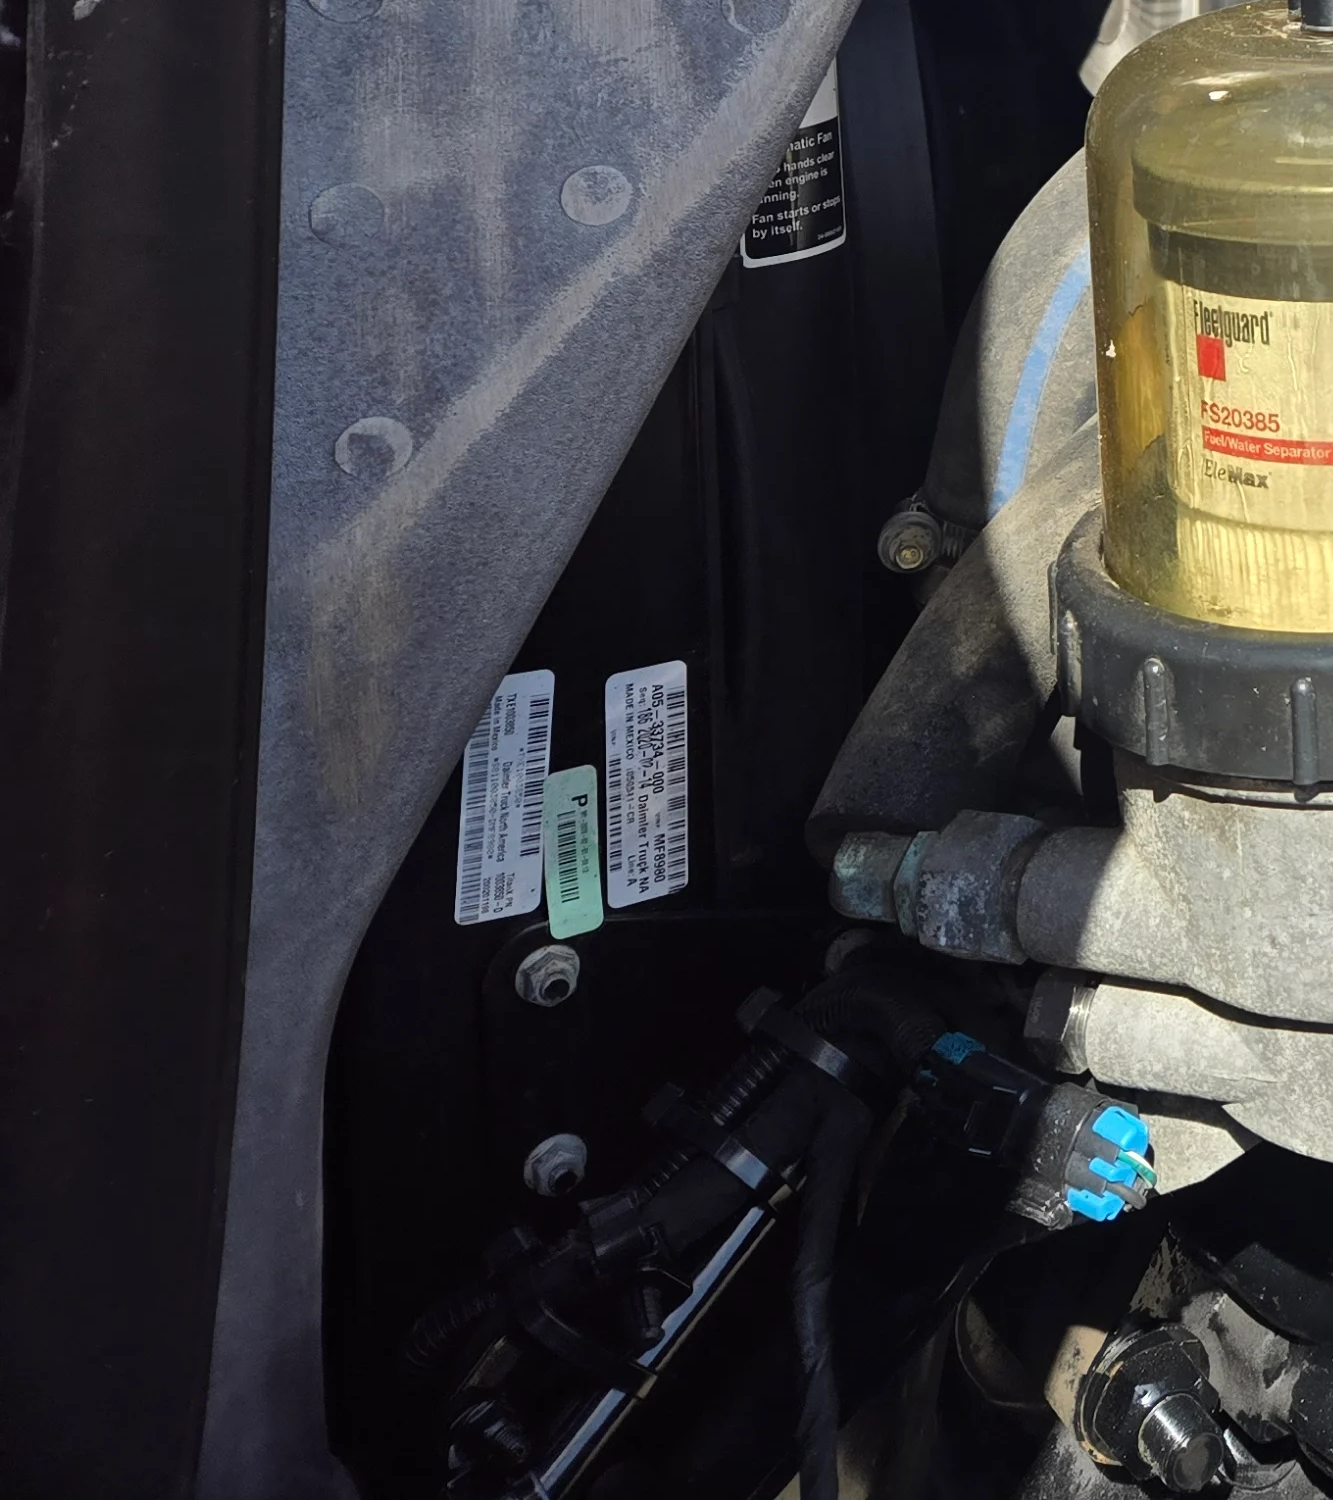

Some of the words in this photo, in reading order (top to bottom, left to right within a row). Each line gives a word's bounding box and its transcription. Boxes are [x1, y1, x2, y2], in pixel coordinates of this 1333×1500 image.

[817, 131, 833, 145] Fan
[783, 157, 816, 172] hands
[816, 150, 835, 164] clear
[785, 171, 819, 187] engine
[752, 212, 774, 225] Fan
[777, 206, 810, 220] starts
[811, 202, 822, 213] or
[822, 194, 841, 209] stops
[752, 227, 768, 240] by
[771, 219, 804, 236] itself.
[1193, 299, 1271, 348] Fleetguard
[1200, 399, 1281, 434] FS20385
[1204, 429, 1262, 455] Fuel/Water
[1263, 441, 1332, 460] Separator
[1204, 458, 1270, 490] EleMax
[493, 695, 503, 716] Made
[625, 682, 634, 711] MADE
[637, 686, 648, 707] Seq:
[490, 726, 501, 751] Mexico
[625, 725, 635, 761] MEXICO
[651, 684, 665, 794] A05-33734-000
[501, 761, 513, 789] Daimler
[571, 793, 588, 807] P
[638, 794, 649, 838] Daimler
[496, 833, 508, 862] America
[636, 841, 650, 874] Truck
[653, 833, 666, 884] MF8980
[638, 876, 650, 895] NA
